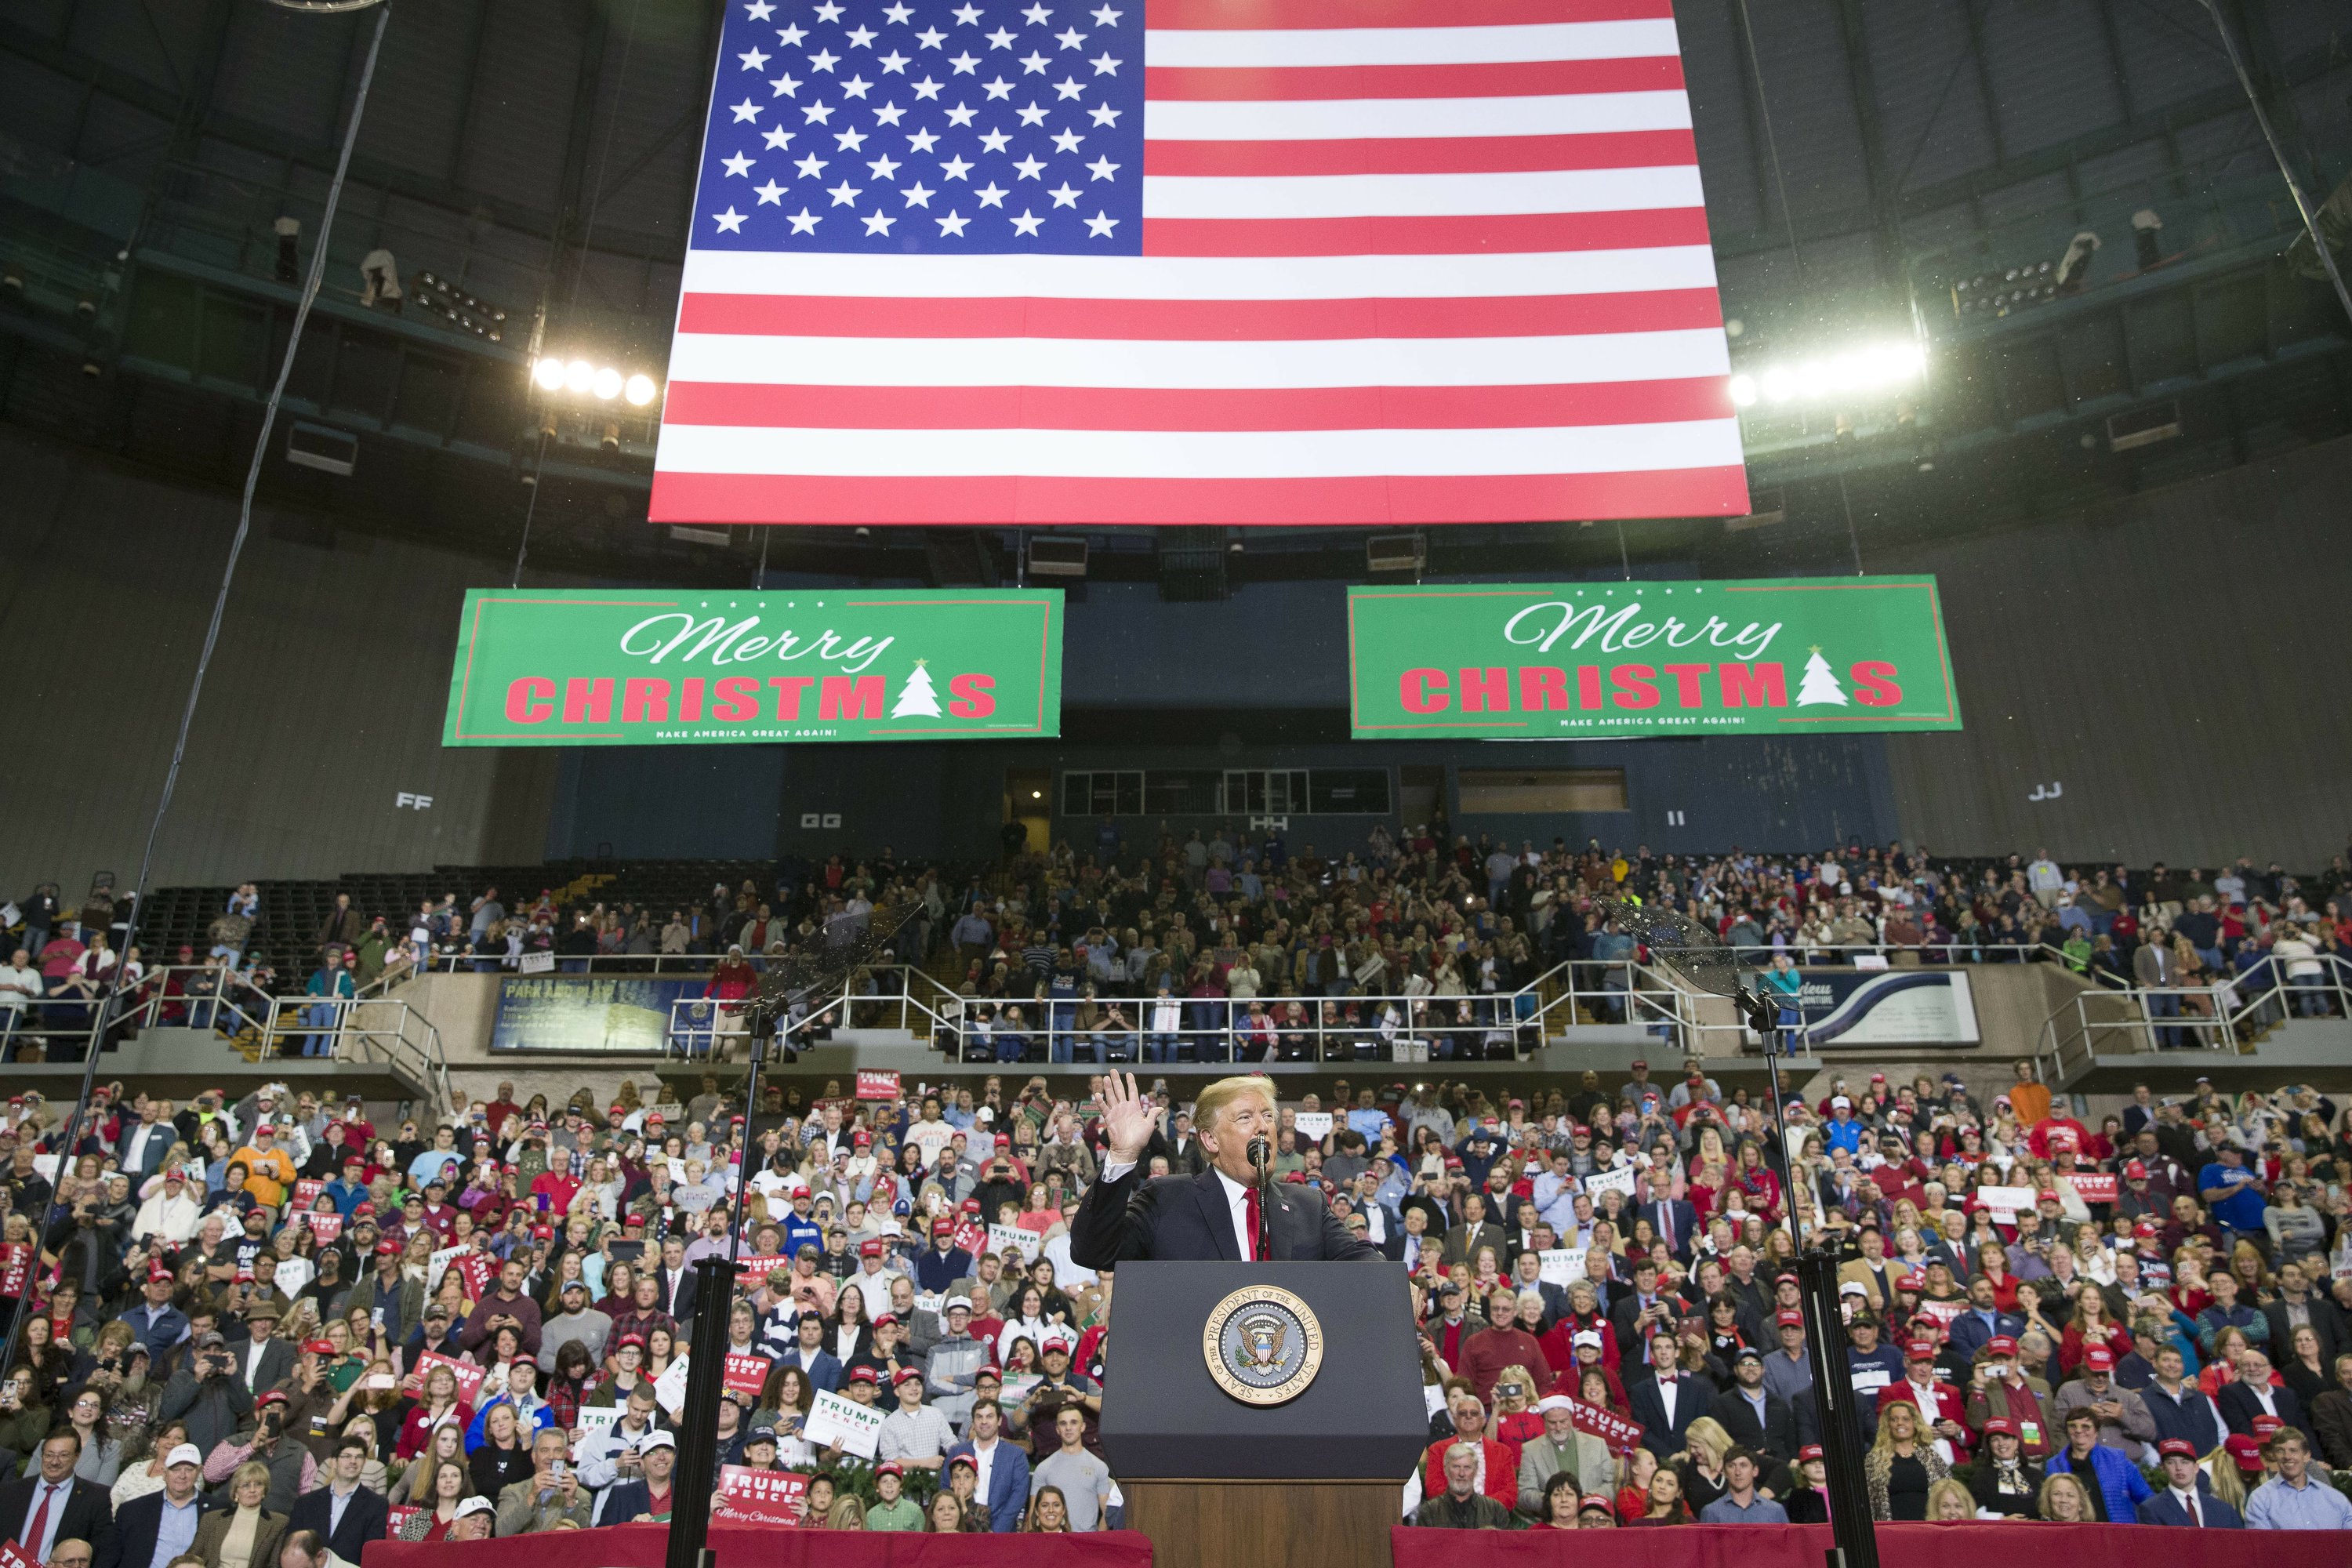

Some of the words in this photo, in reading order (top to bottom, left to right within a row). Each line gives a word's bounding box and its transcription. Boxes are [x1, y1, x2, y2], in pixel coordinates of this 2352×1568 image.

[1504, 601, 1782, 660] Merry
[619, 614, 895, 673] Merry
[1599, 717, 1652, 726] AMERICA
[1658, 717, 1696, 725] GREAT
[657, 730, 688, 739] MAKE
[2028, 781, 2063, 801] JJ
[396, 792, 433, 811] FF
[801, 814, 841, 828] GG
[1250, 816, 1287, 830] HH
[506, 985, 542, 998] PARK
[299, 1182, 322, 1191] TRU
[292, 1214, 341, 1225] TUMP
[993, 1229, 1036, 1243] TRUMP
[1542, 1254, 1584, 1263] RUMP
[1262, 1290, 1274, 1299] OF
[1276, 1293, 1291, 1305] THE
[1207, 1290, 1259, 1342] PRESIDENT
[1293, 1303, 1319, 1352] UNITED
[1209, 1345, 1218, 1363] THE
[728, 1357, 767, 1370] UMP
[1214, 1363, 1225, 1375] OF
[1224, 1376, 1254, 1398] SEAL
[1276, 1361, 1316, 1399] STATES
[819, 1397, 880, 1425] TRUMP
[1574, 1403, 1640, 1437] TRUMP
[821, 1409, 871, 1432] PENCE
[1576, 1412, 1630, 1442] PENCE
[724, 1472, 804, 1494] TRUMP
[728, 1486, 792, 1504] PENCE
[716, 1506, 748, 1523] Merry
[749, 1510, 797, 1526] Christmas
